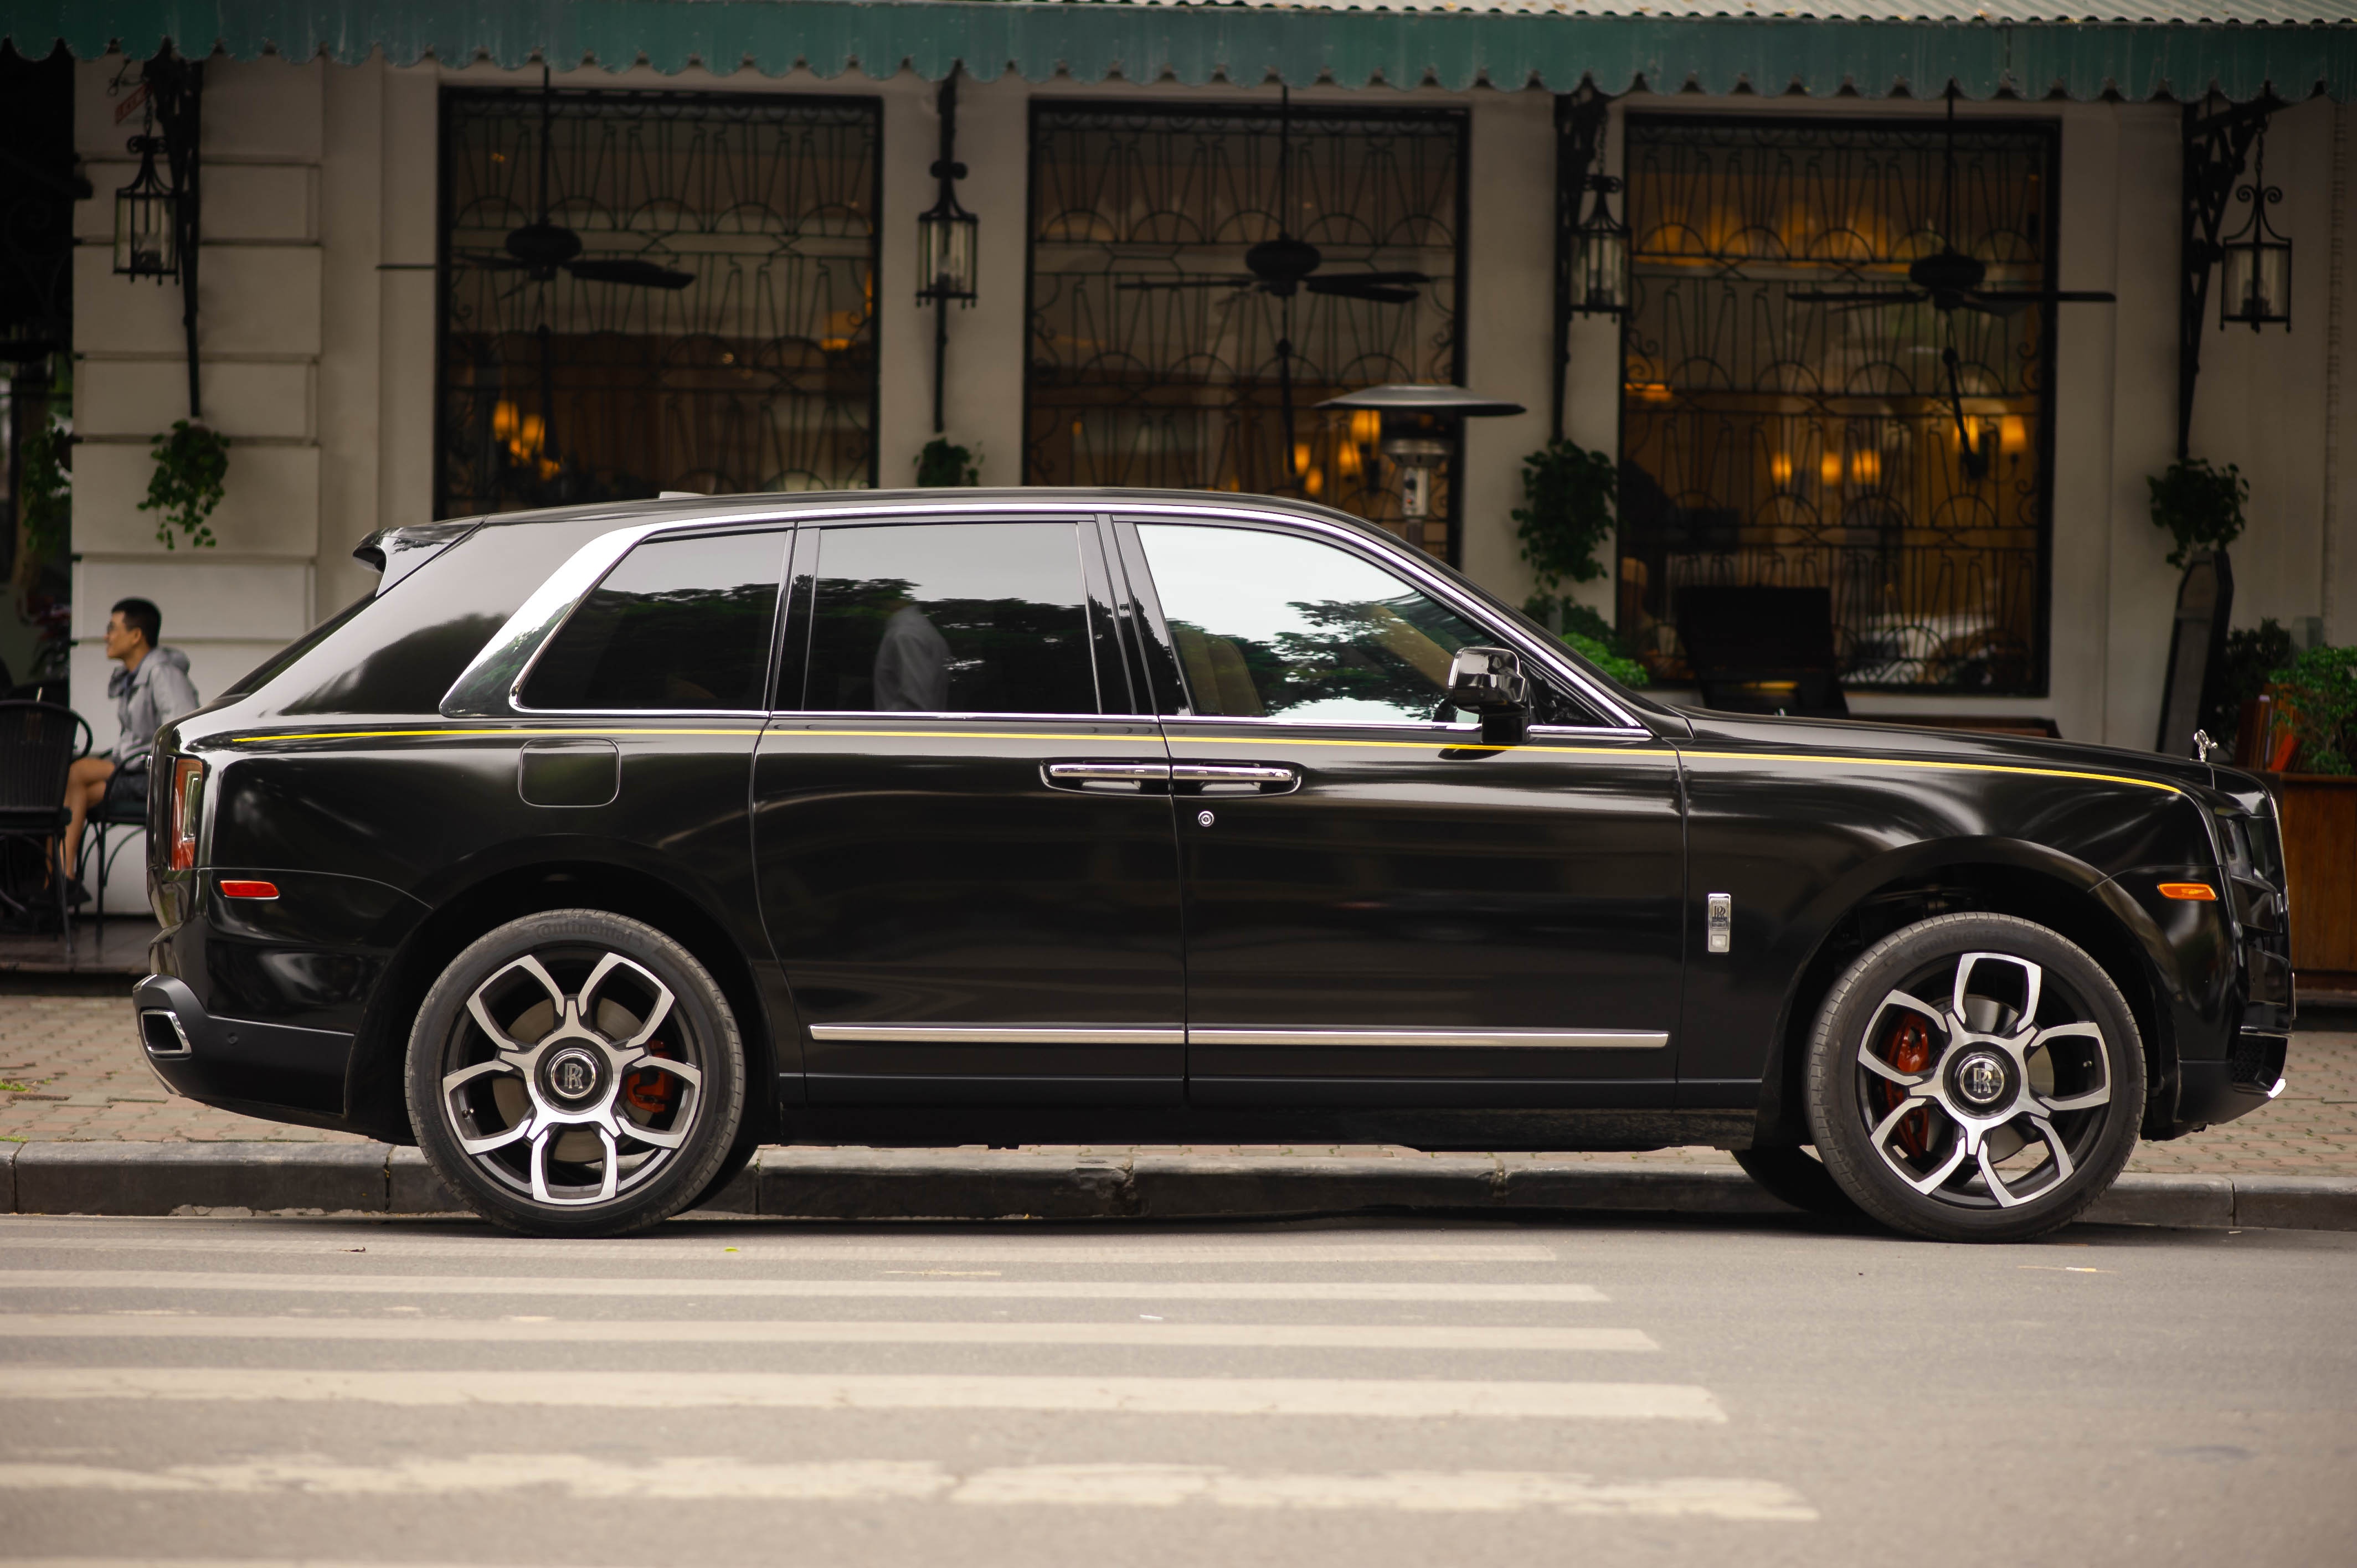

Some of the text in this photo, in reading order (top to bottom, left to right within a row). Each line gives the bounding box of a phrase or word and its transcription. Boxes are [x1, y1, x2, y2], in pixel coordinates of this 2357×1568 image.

[536, 921, 633, 944] Continental
[564, 1063, 583, 1089] RR
[1973, 1067, 1993, 1094] RR
